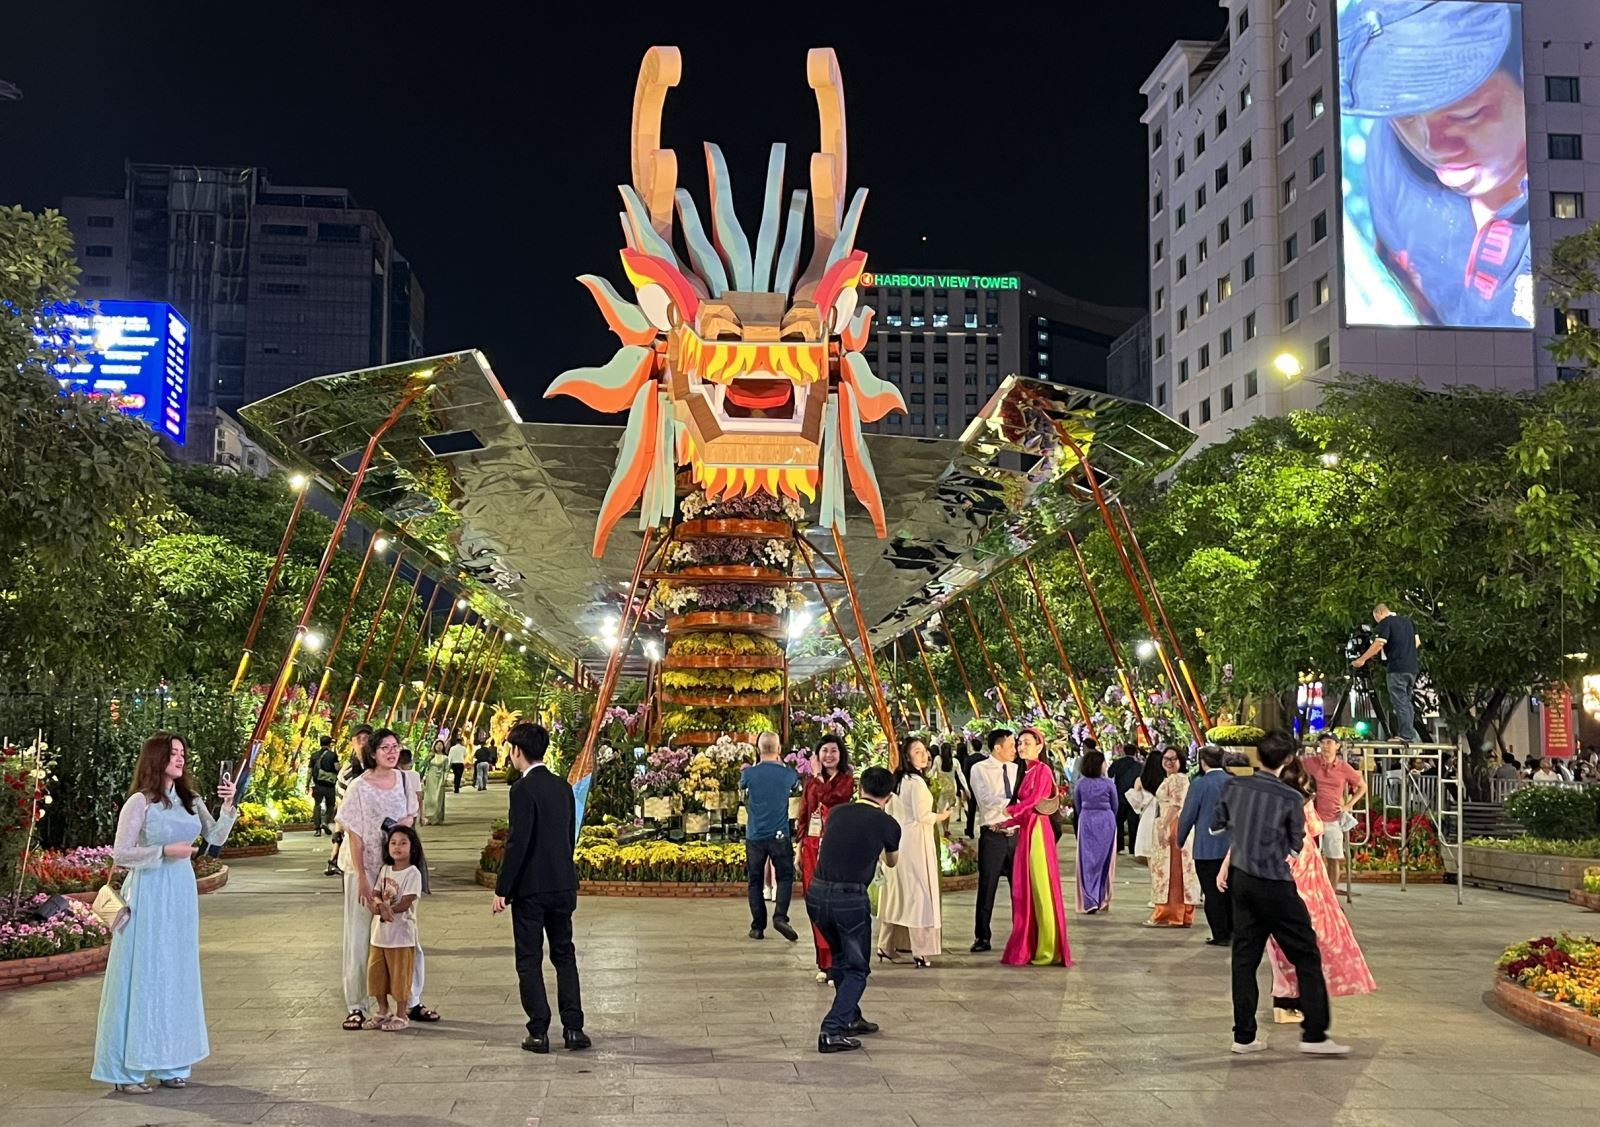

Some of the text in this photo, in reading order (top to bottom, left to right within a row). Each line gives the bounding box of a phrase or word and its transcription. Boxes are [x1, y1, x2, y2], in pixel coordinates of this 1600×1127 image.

[874, 274, 1018, 289] HARBOUR VIEW TOWER
